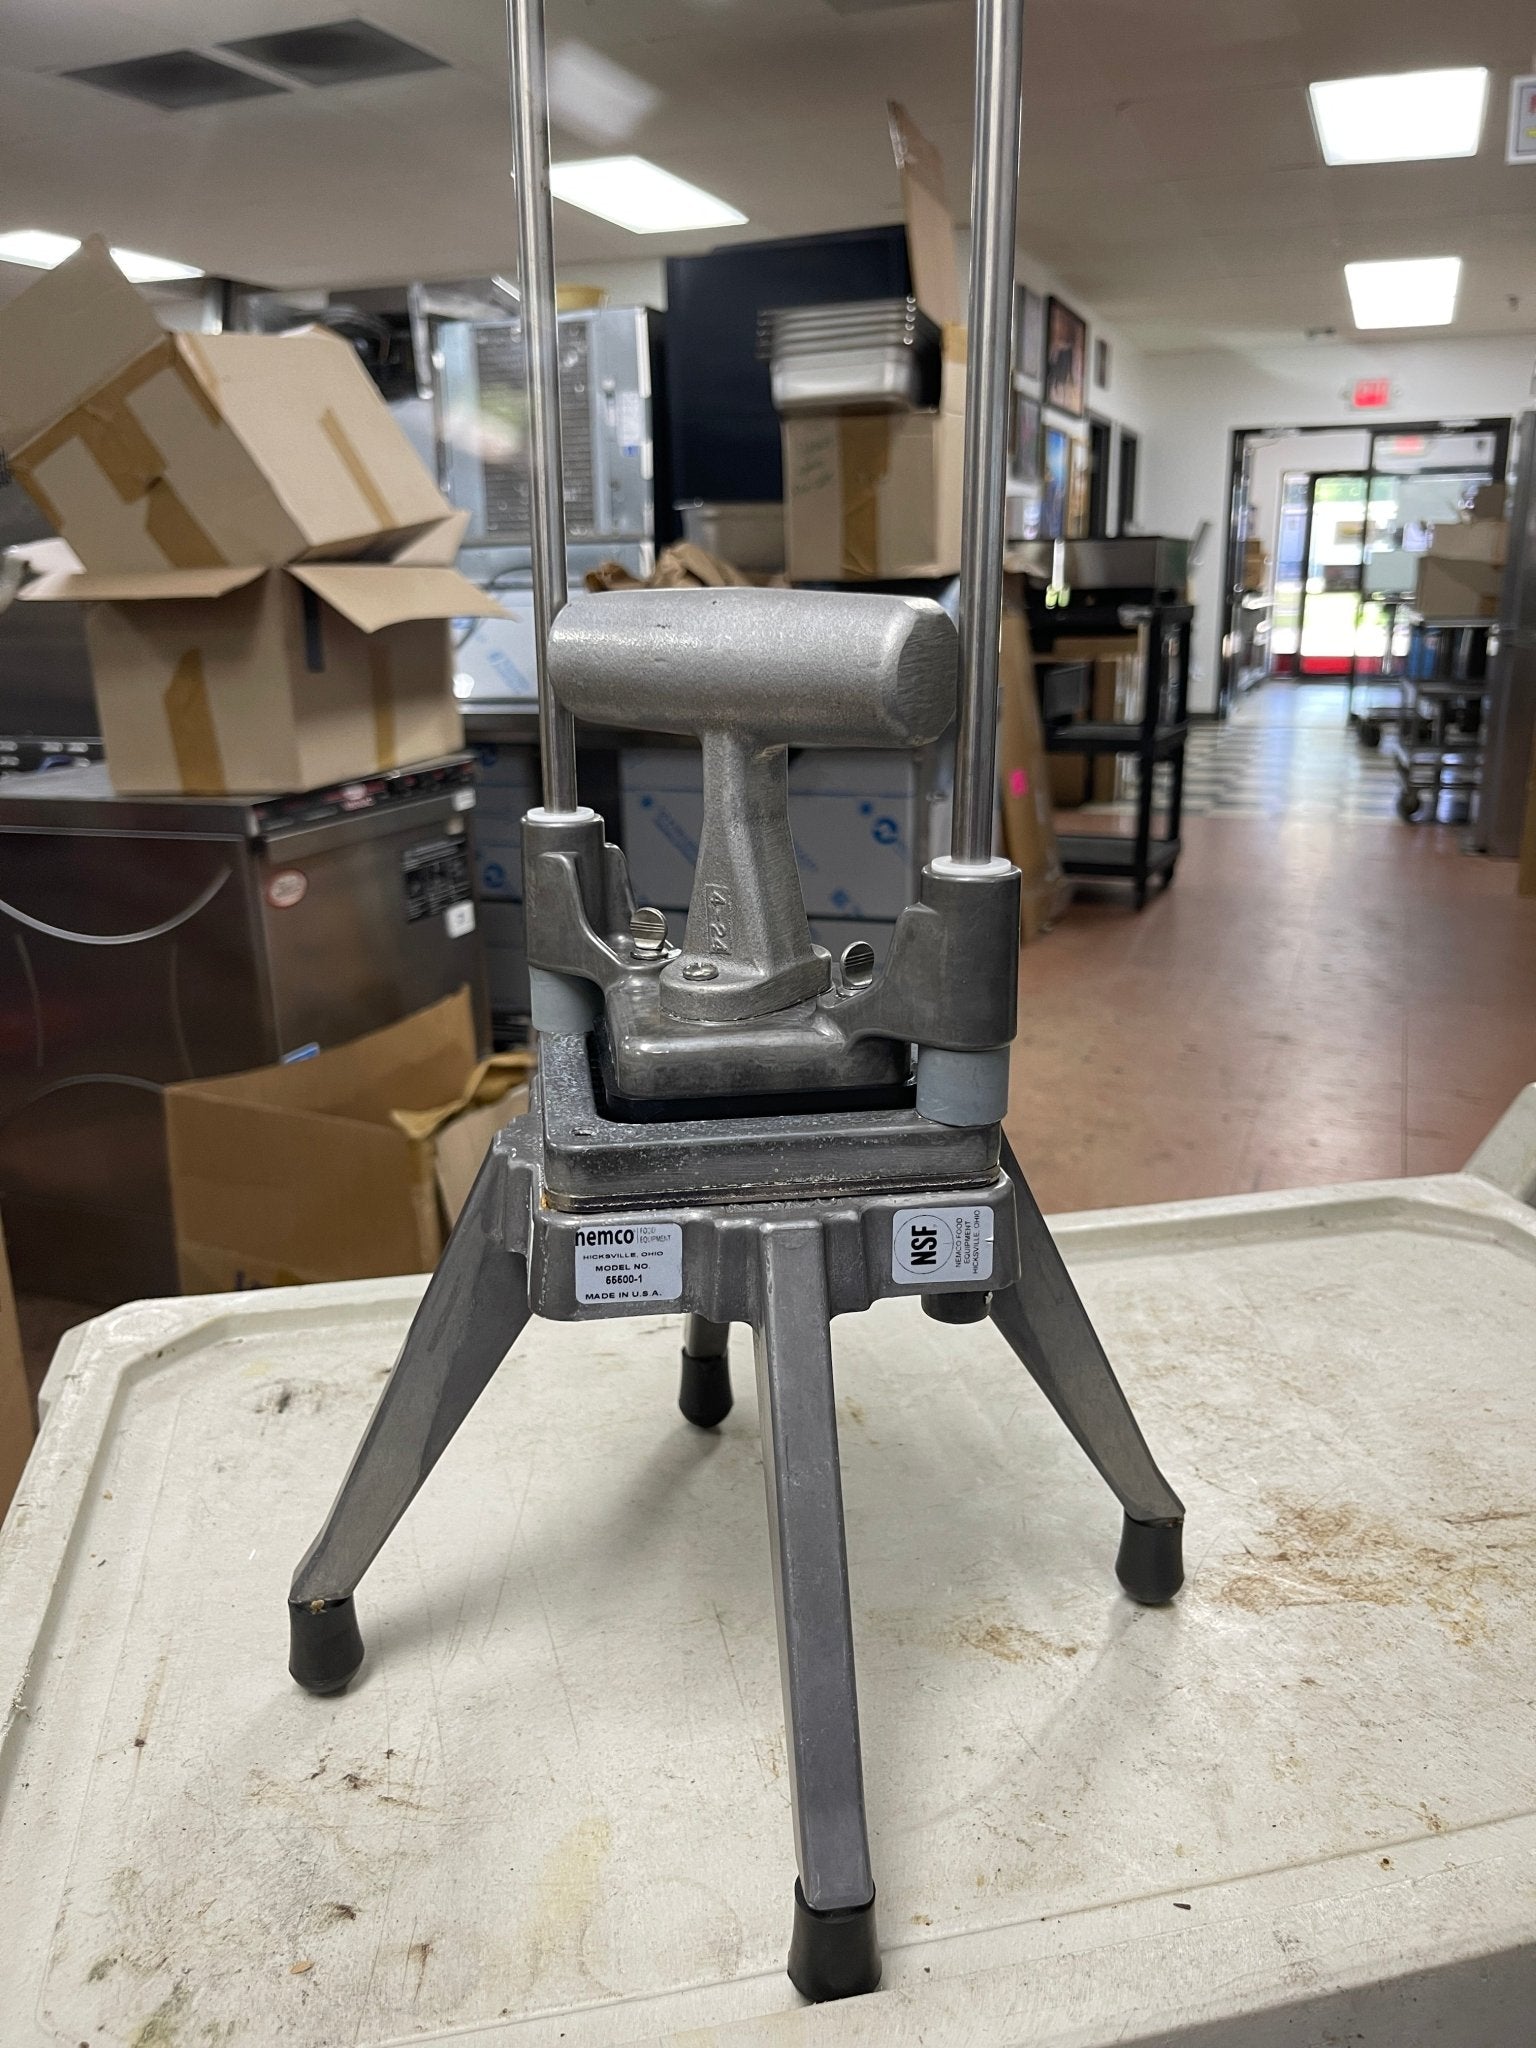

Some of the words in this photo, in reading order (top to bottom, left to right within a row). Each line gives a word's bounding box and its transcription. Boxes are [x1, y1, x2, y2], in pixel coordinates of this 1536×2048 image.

[955, 1217, 963, 1239] FOOD
[973, 1210, 981, 1229] OHIO
[575, 1229, 634, 1246] nemco
[911, 1225, 937, 1265] NSF
[963, 1221, 971, 1264] EQUIPMENT
[585, 1292, 615, 1300] MADE
[632, 1290, 662, 1298] U.S.A.
